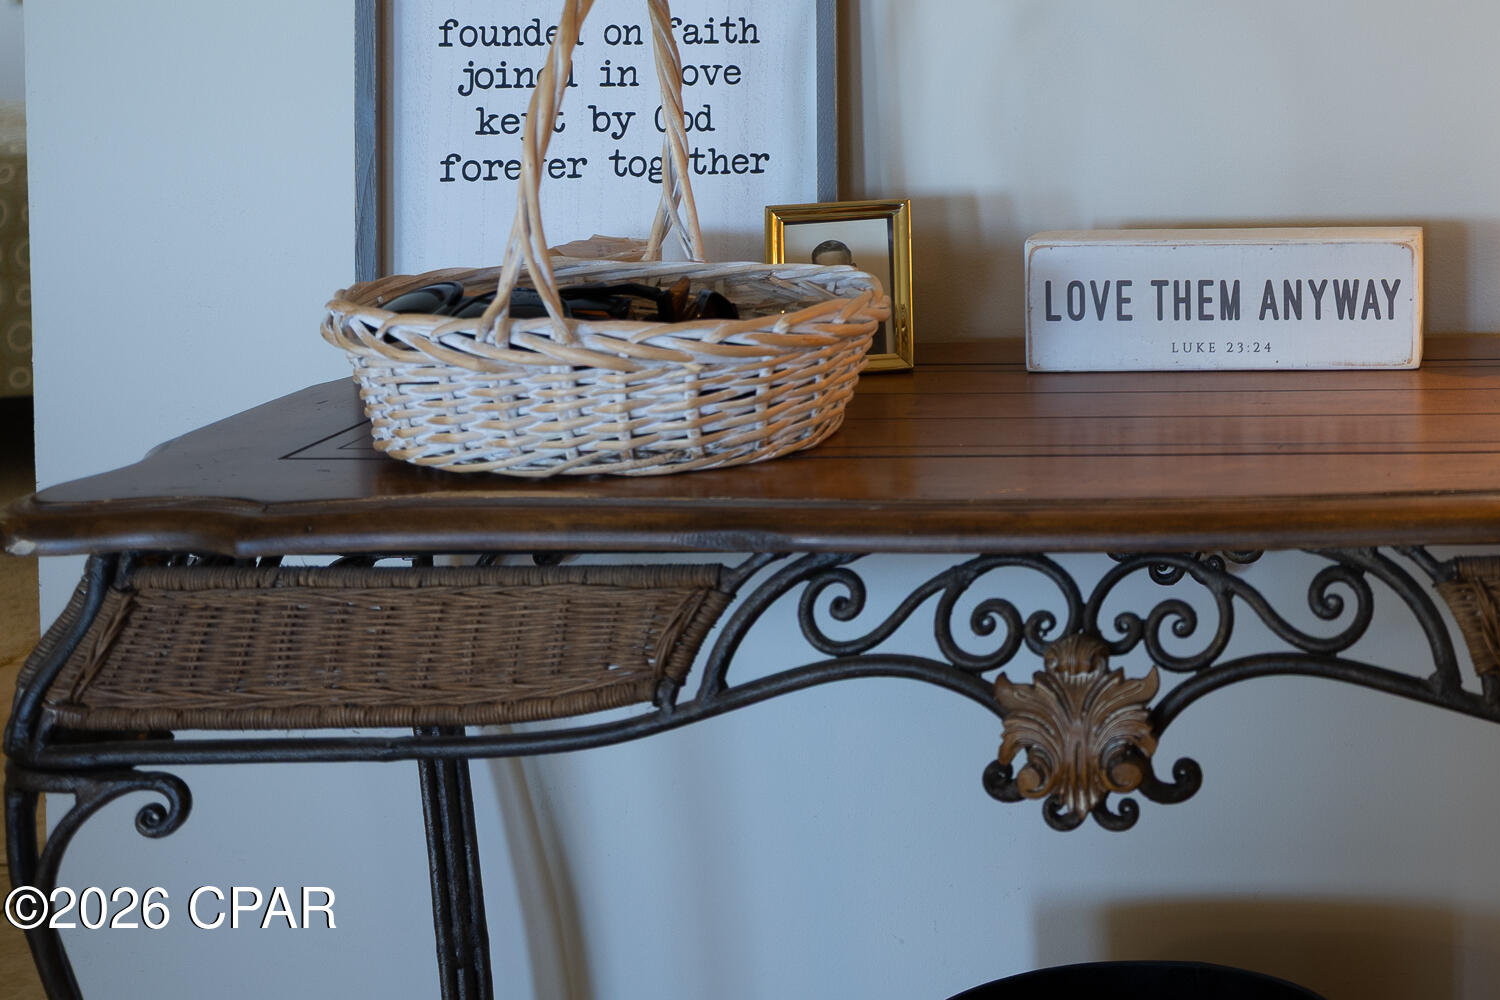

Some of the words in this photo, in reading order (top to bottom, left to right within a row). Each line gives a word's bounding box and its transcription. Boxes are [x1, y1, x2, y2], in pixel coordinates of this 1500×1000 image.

[438, 18, 584, 48] founde
[603, 24, 643, 46] on
[457, 60, 578, 97] join
[599, 60, 640, 87] in
[681, 64, 742, 87] ove
[475, 107, 566, 141] ket
[587, 104, 636, 140] by
[439, 153, 588, 183] foreer
[608, 147, 770, 184] togther
[1044, 278, 1133, 322] LOVE
[1150, 278, 1241, 322] THEM
[1258, 278, 1402, 321] ANYWAY
[1171, 342, 1217, 354] LUKE
[1226, 341, 1272, 354] 23:24
